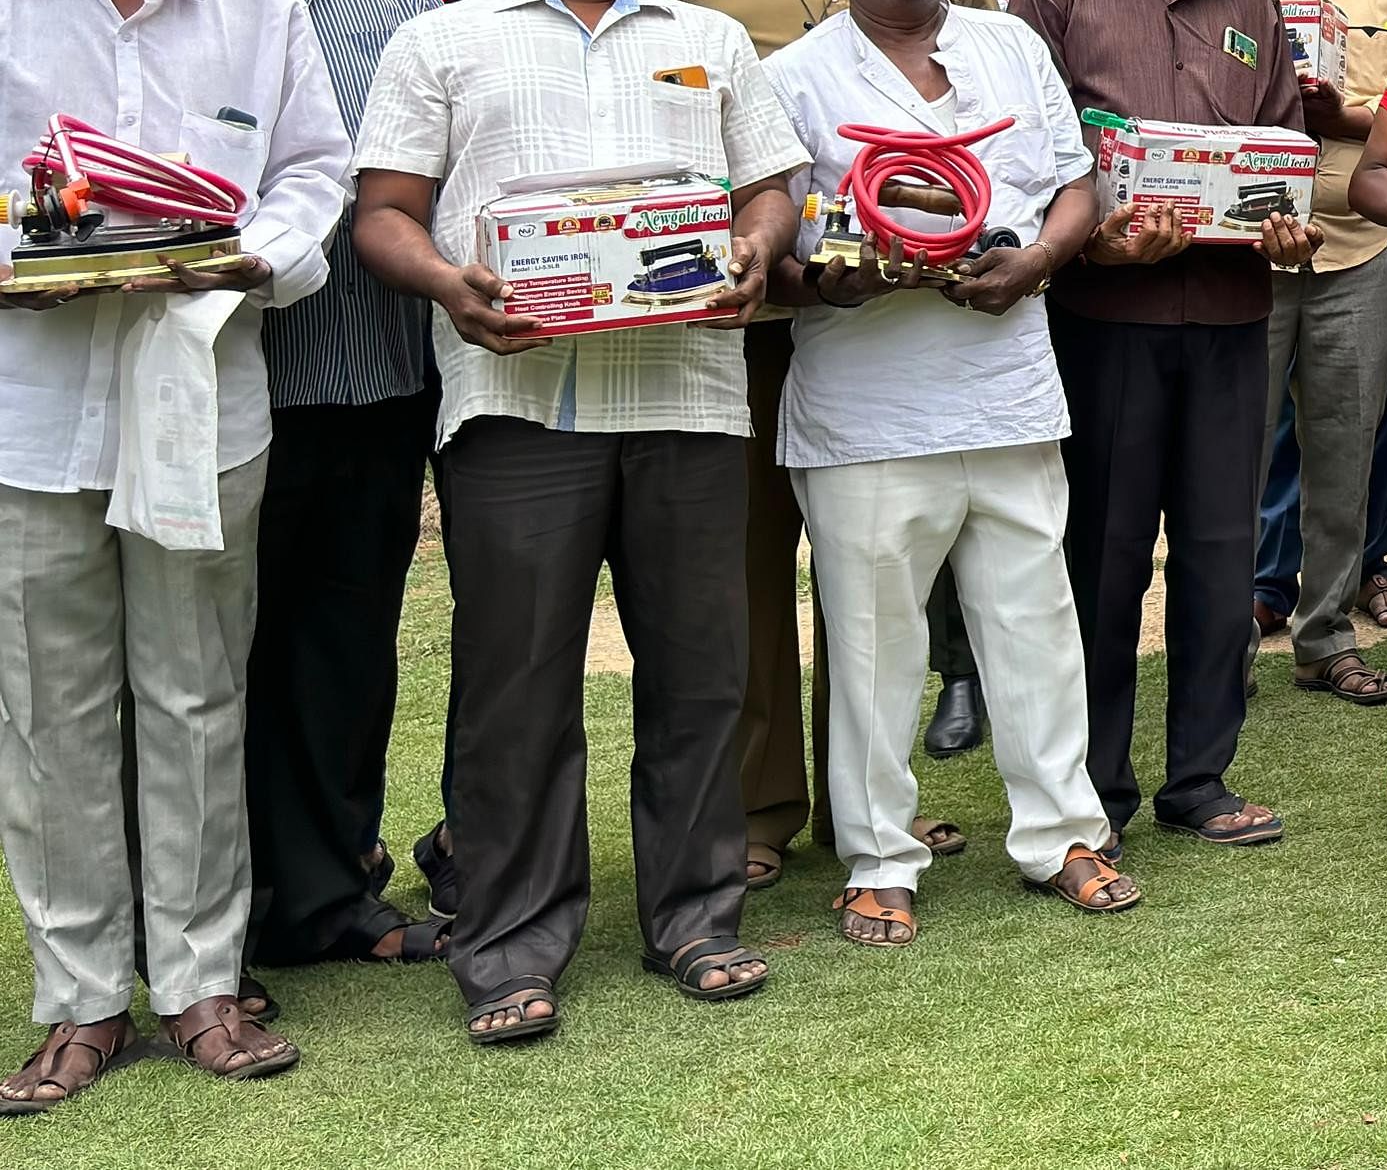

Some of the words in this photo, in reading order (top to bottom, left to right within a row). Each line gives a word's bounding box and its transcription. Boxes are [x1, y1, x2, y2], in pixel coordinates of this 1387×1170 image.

[1240, 152, 1291, 170] Newgold
[1294, 158, 1311, 167] tech
[636, 205, 699, 232] Newgold
[702, 206, 727, 222] tech
[511, 258, 539, 266] ENERGY
[542, 254, 568, 264] SAVING
